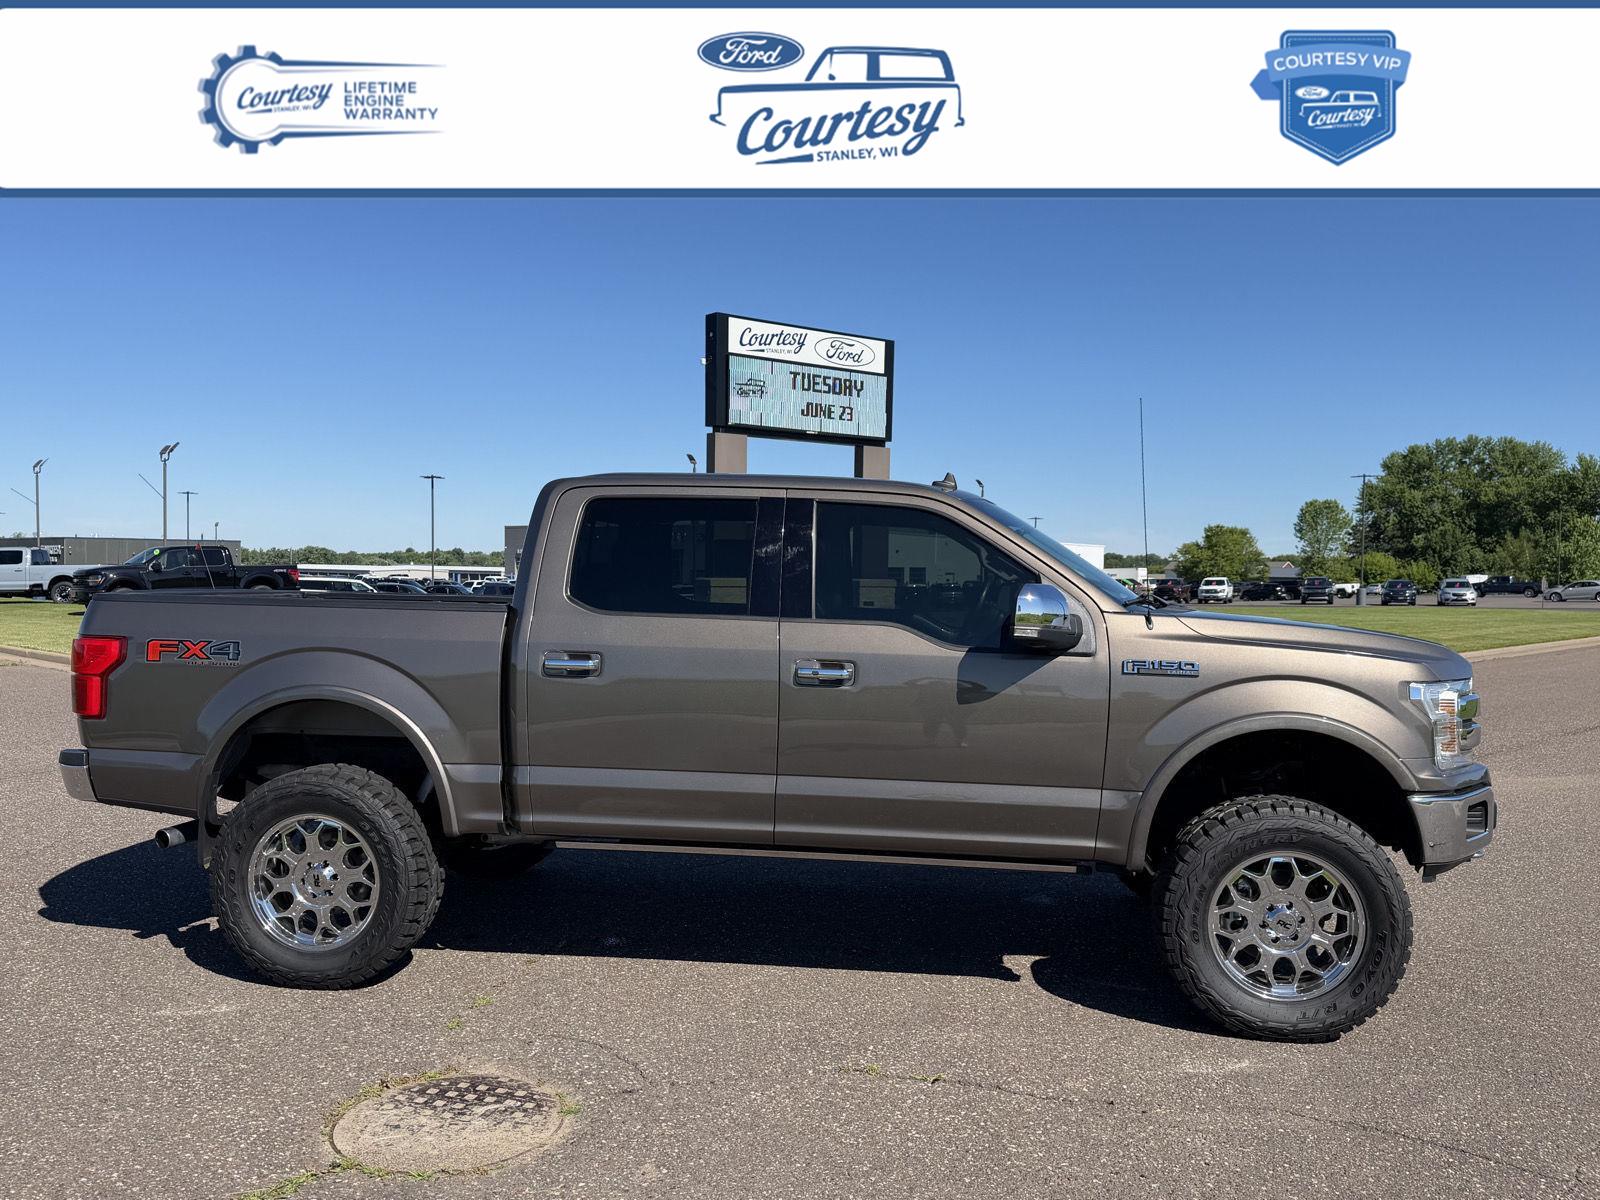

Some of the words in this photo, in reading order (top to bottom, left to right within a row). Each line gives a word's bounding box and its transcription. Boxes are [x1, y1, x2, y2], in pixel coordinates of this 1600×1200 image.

[739, 327, 808, 354] Courtesy
[826, 339, 865, 363] Ford
[789, 371, 864, 398] TUESDAY
[801, 401, 835, 419] JUNE
[838, 405, 853, 421] 23
[146, 638, 241, 662] FX4
